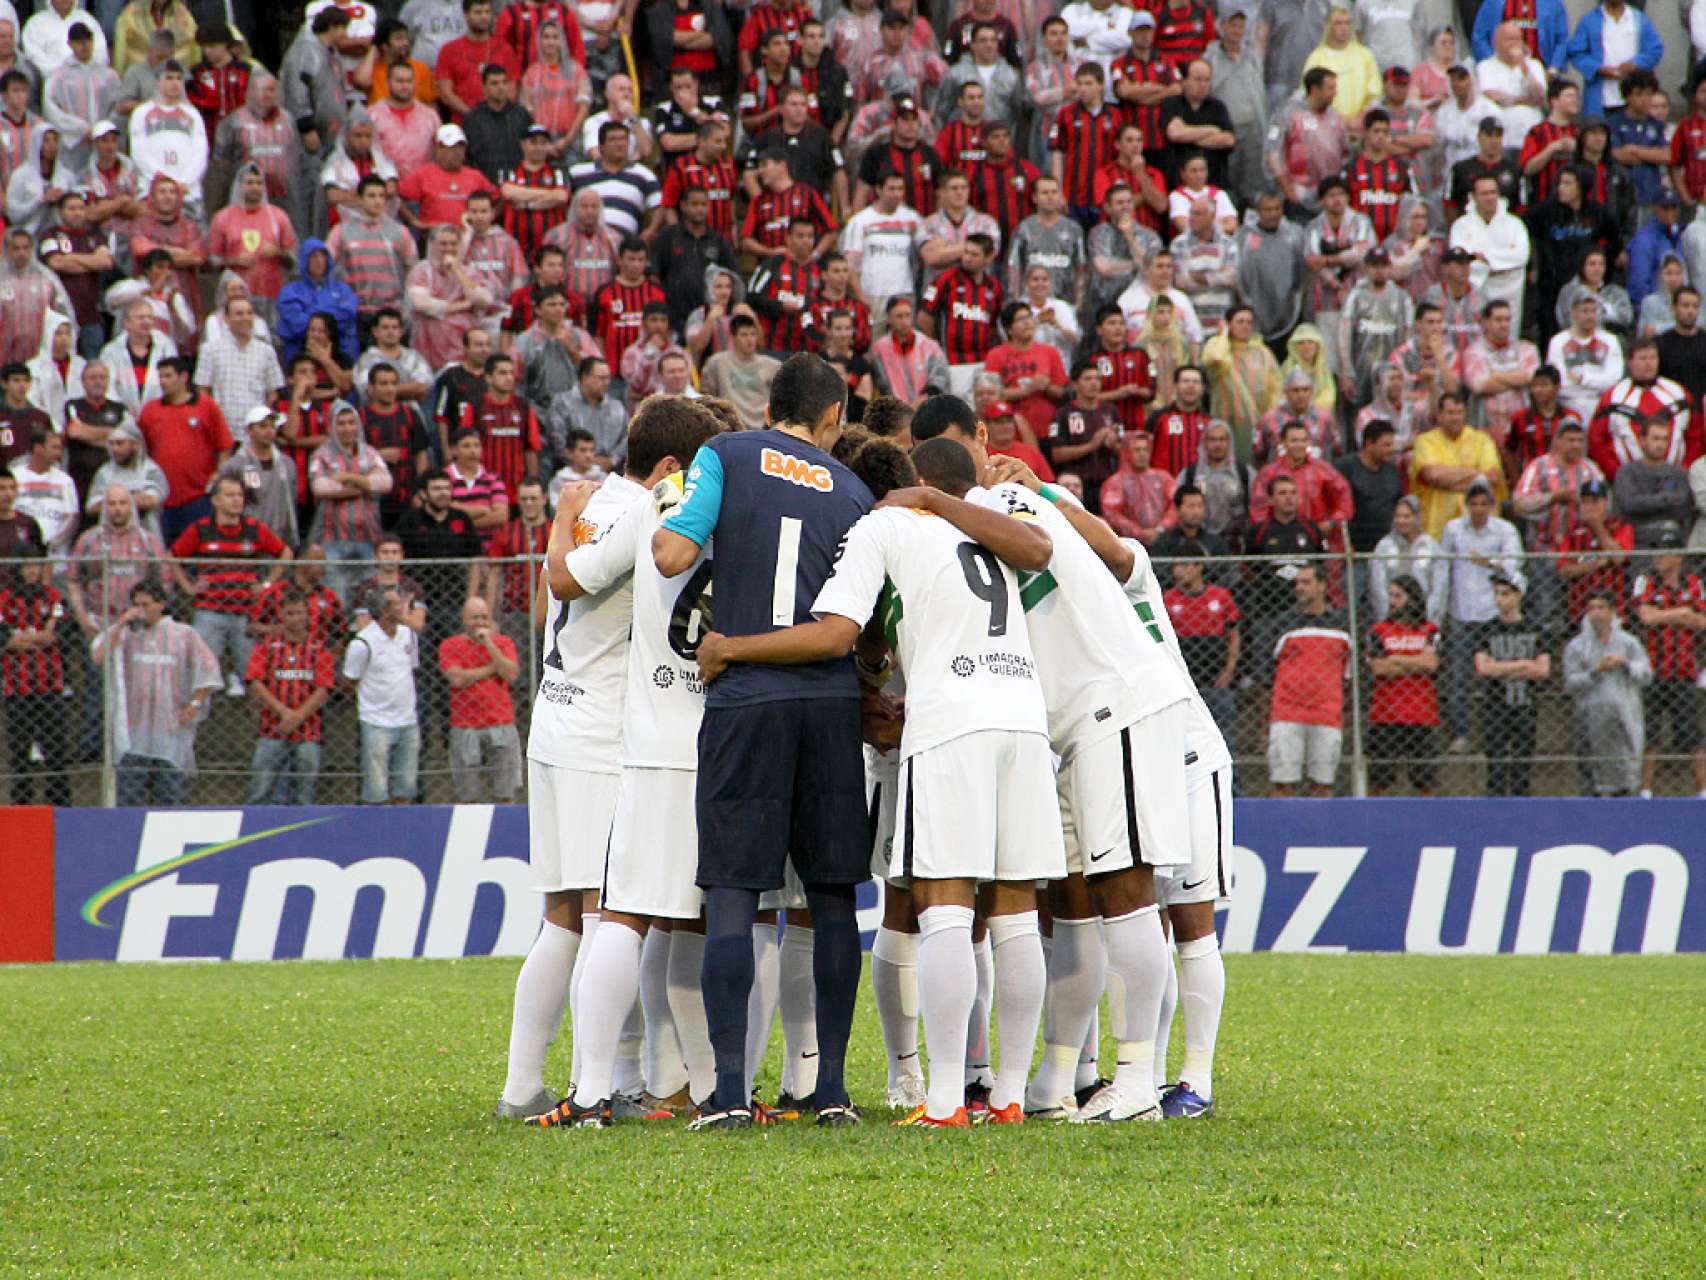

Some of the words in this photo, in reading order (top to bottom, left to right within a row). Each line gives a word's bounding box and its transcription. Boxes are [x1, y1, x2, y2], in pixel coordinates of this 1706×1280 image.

[761, 448, 833, 492] BMG
[773, 516, 802, 627] 1
[957, 541, 1008, 636] 9
[1405, 844, 1690, 954] um
